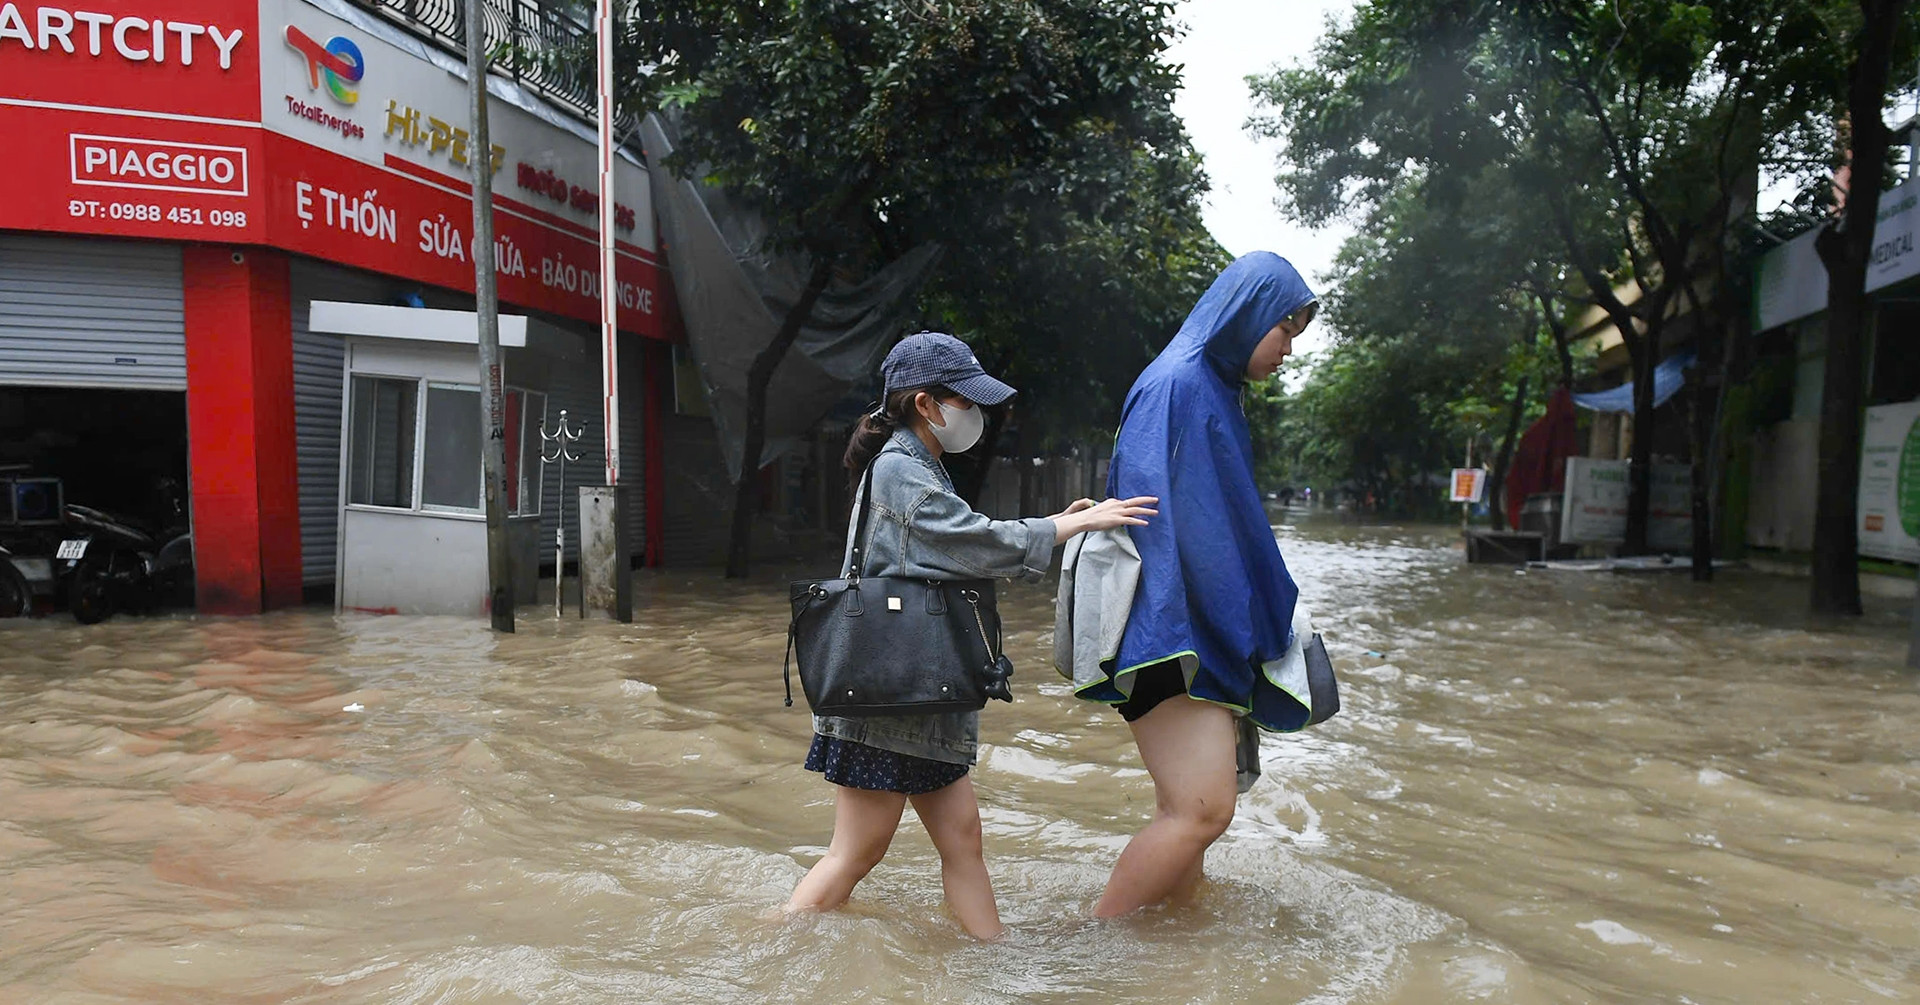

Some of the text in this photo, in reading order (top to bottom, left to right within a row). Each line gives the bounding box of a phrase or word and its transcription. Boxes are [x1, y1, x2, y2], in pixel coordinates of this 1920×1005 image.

[0, 2, 243, 70] ARTCITY
[285, 95, 365, 139] TotalEnergies
[84, 146, 235, 184] PIAGGIO
[68, 200, 247, 228] ĐT: 0988 451 098
[419, 213, 465, 262] SỬA
[542, 252, 577, 292] BẢO
[636, 285, 652, 314] XE
